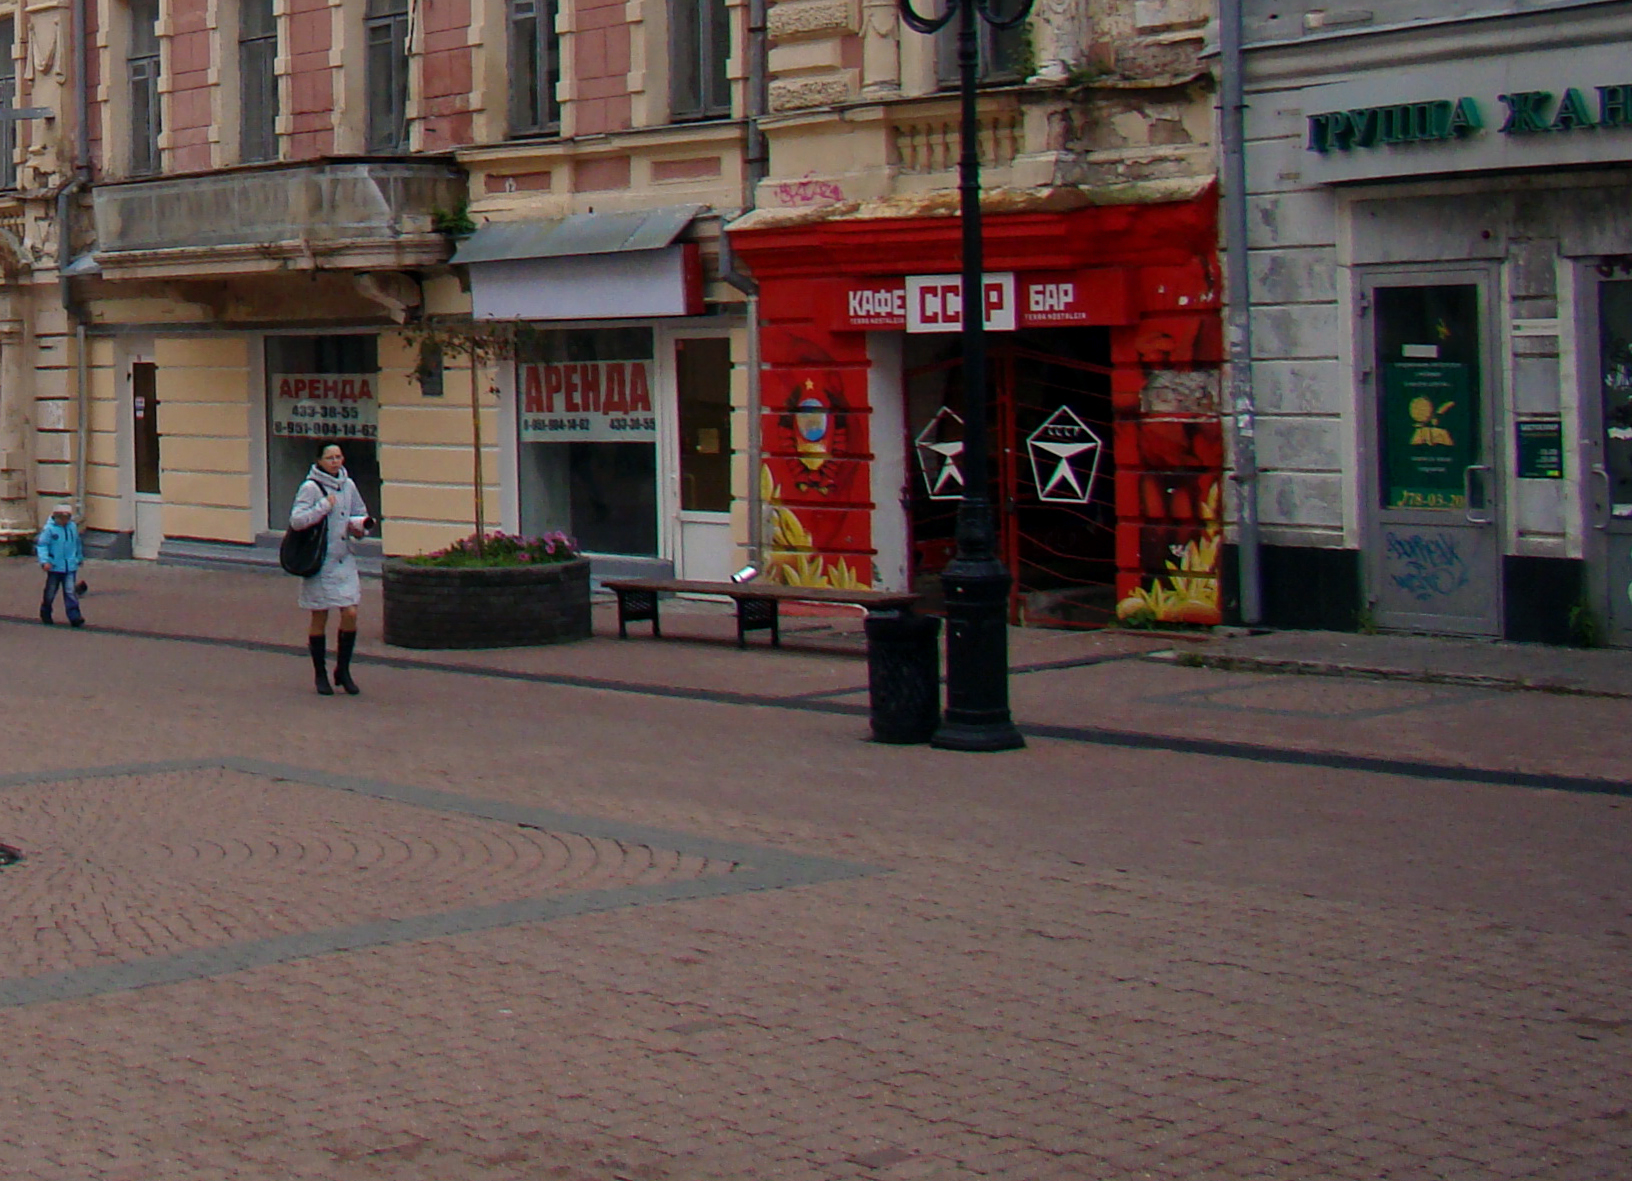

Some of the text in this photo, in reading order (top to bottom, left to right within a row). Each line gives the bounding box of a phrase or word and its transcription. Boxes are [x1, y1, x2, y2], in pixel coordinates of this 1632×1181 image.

[1305, 96, 1484, 153] ГРУППА
[847, 281, 1074, 325] КАФЕ ССР БАР
[279, 377, 374, 403] АРЕНДА
[524, 361, 652, 416] АРЕНДА
